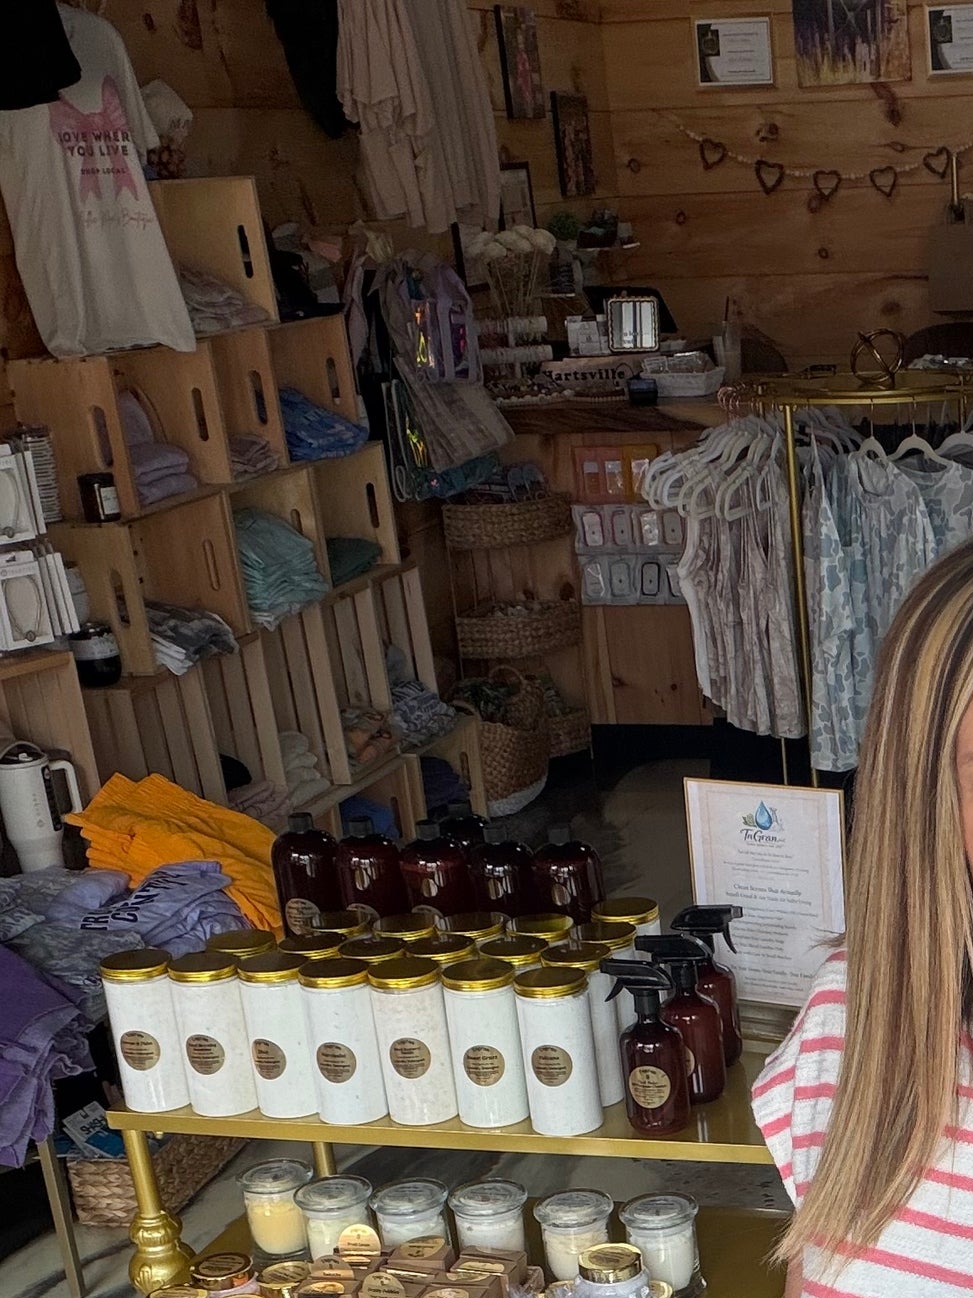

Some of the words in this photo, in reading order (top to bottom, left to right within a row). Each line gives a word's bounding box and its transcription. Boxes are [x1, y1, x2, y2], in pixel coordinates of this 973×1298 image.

[92, 130, 131, 143] WHER
[68, 145, 95, 158] YOU
[99, 145, 130, 157] LIVE
[542, 368, 625, 382] Hartsville
